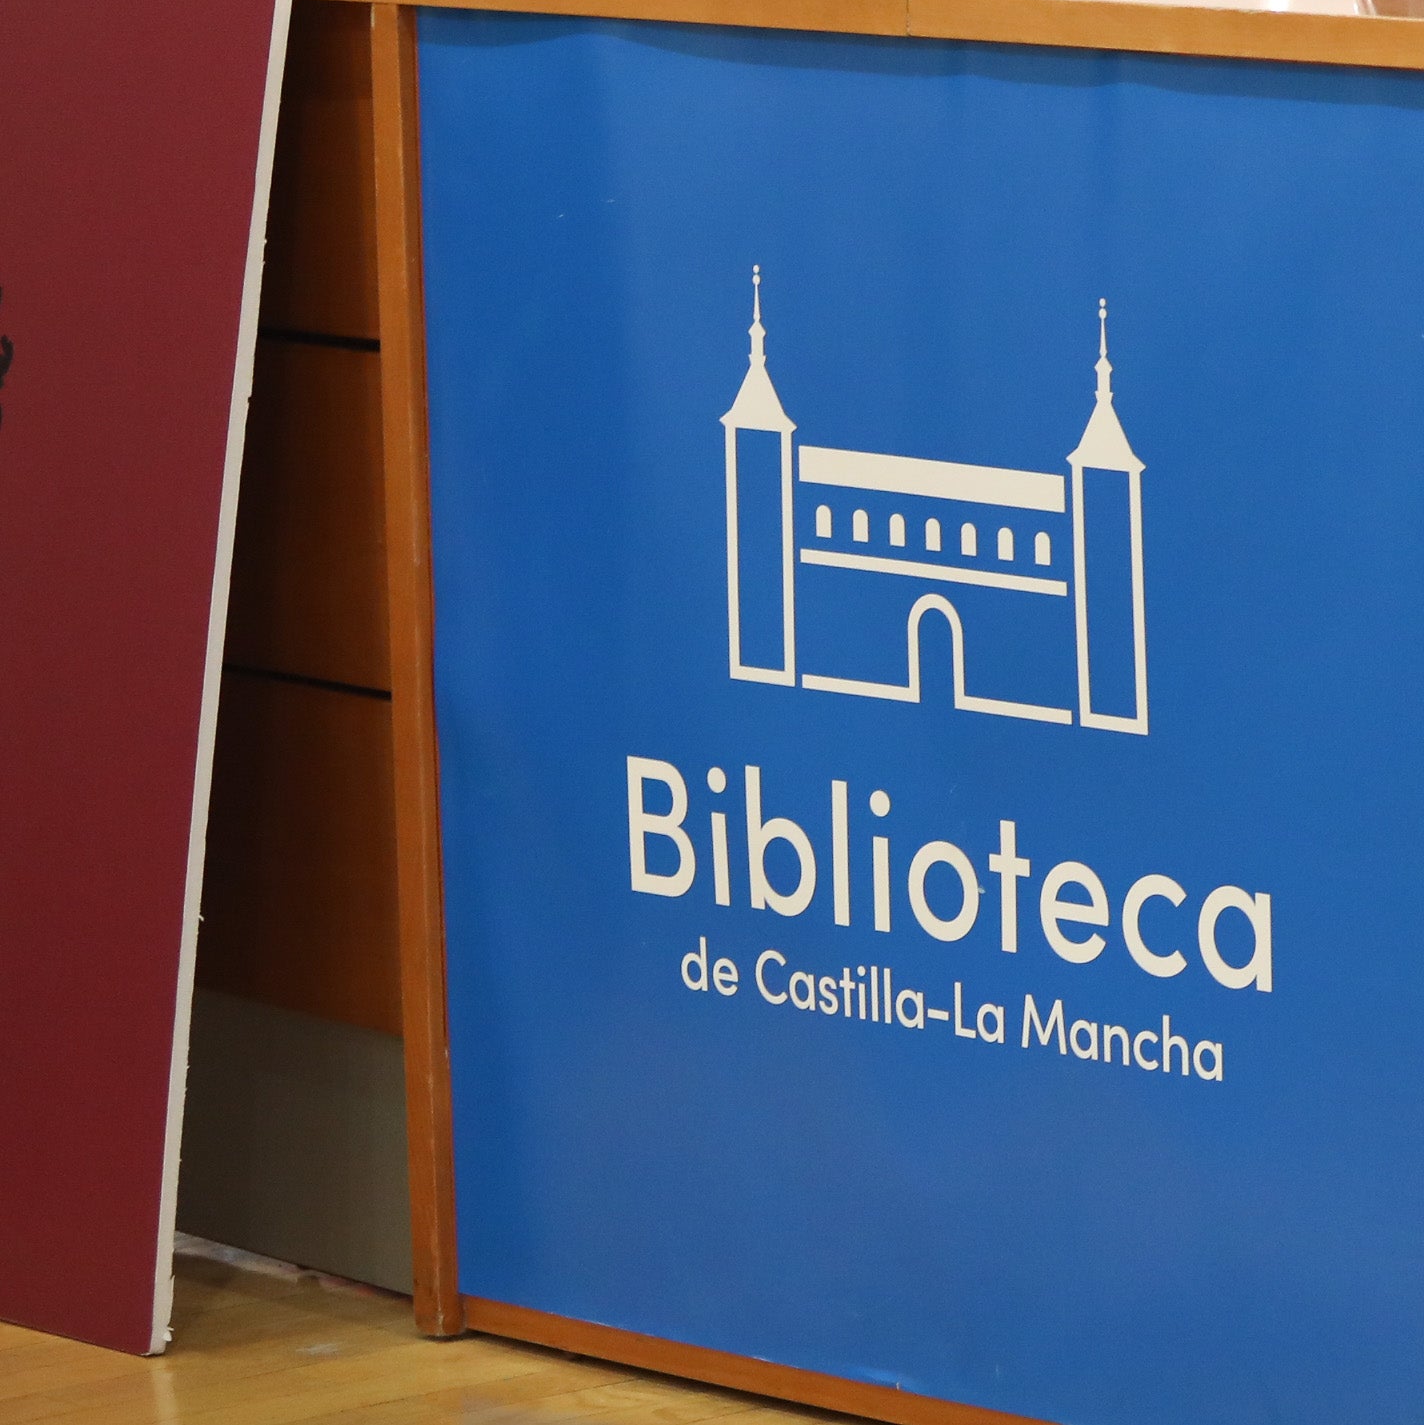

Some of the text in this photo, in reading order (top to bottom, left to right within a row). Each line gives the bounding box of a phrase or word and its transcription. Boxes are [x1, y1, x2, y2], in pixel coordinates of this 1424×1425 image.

[626, 754, 1273, 994] Biblioteca
[680, 935, 1224, 1082] de Castilla-La Mancha
